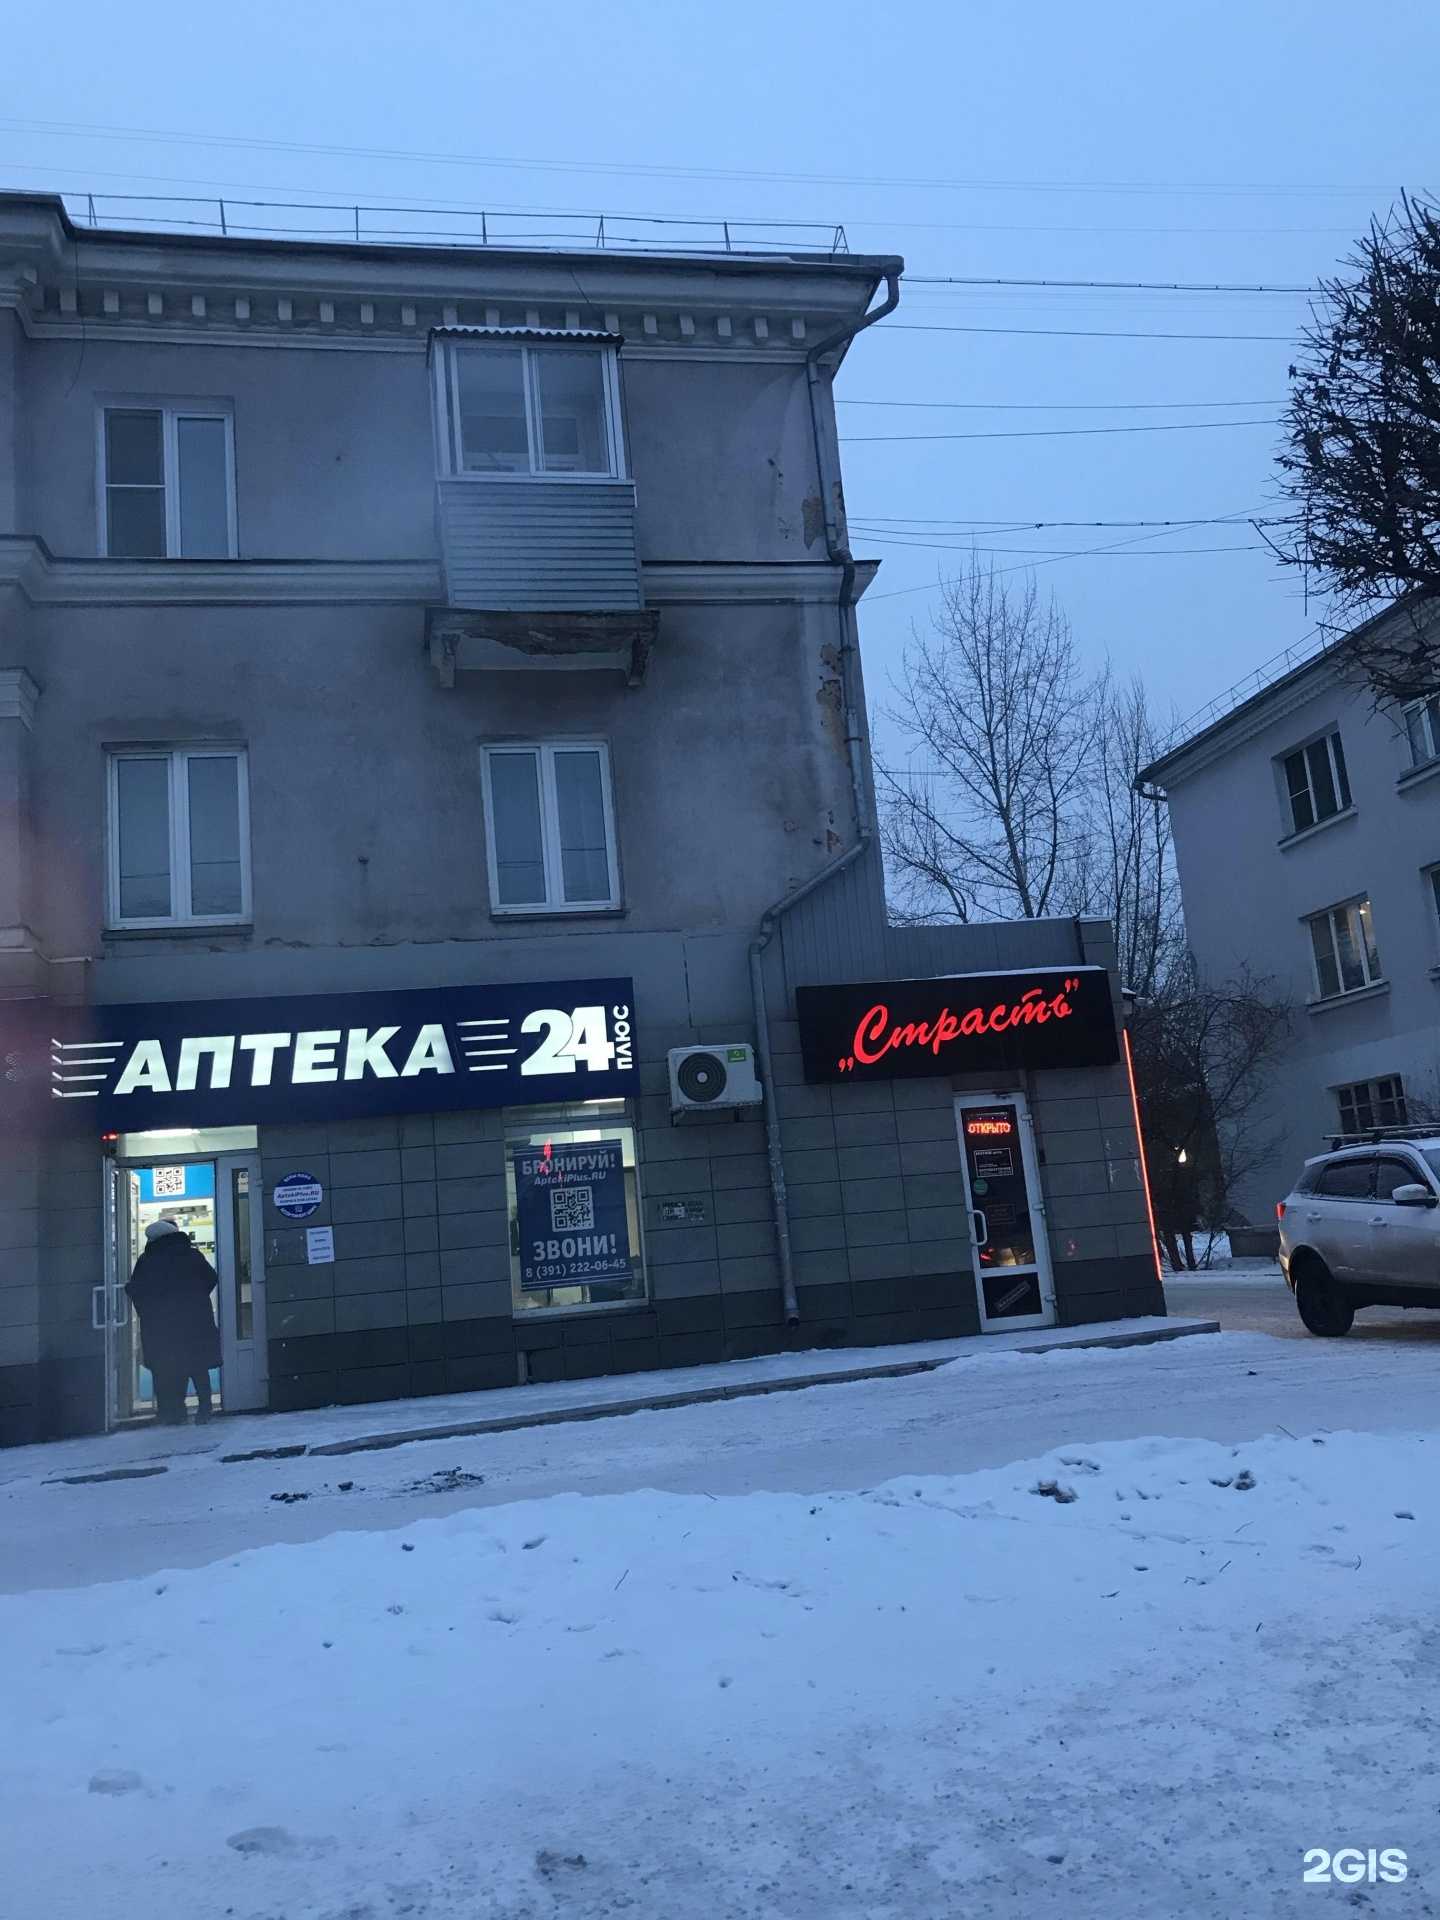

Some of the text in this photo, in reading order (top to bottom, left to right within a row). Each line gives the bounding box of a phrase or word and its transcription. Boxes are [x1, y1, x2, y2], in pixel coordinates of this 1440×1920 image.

[113, 1006, 616, 1095] АПТЕКА 24
[612, 1005, 633, 1070] ПЛЮС
[967, 1122, 1012, 1135] ОТКРЫТО
[522, 1149, 616, 1176] БРОНИРУЙ!
[532, 1234, 617, 1262] ЗВОНИ!
[525, 1267, 533, 1279] 8
[536, 1264, 567, 1279] (391)
